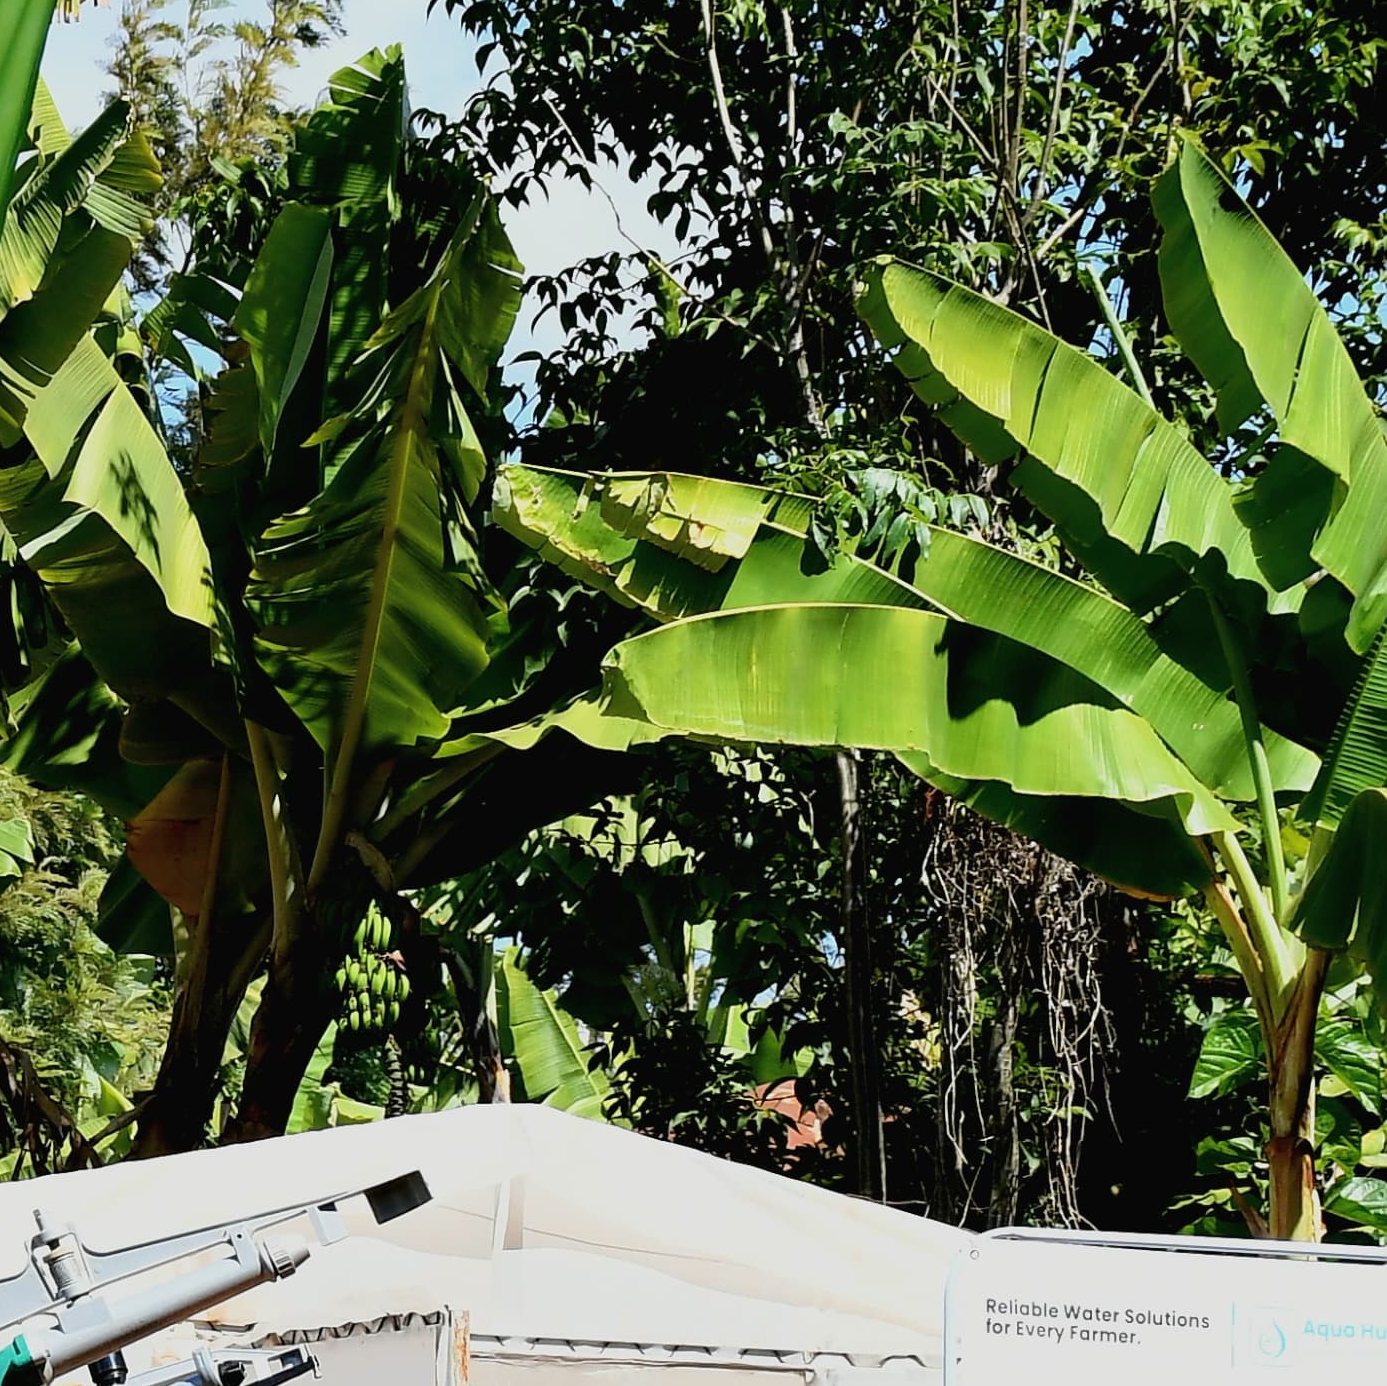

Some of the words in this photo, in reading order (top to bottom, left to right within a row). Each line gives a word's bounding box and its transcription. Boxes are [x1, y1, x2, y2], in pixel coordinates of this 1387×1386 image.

[985, 1298, 1059, 1319] Reliable
[1063, 1304, 1120, 1323] Water
[1125, 1308, 1211, 1329] Solutions
[985, 1318, 1011, 1335] for
[1015, 1321, 1065, 1344] Every
[1070, 1325, 1142, 1345] Farmer.
[1303, 1319, 1356, 1342] Aqua
